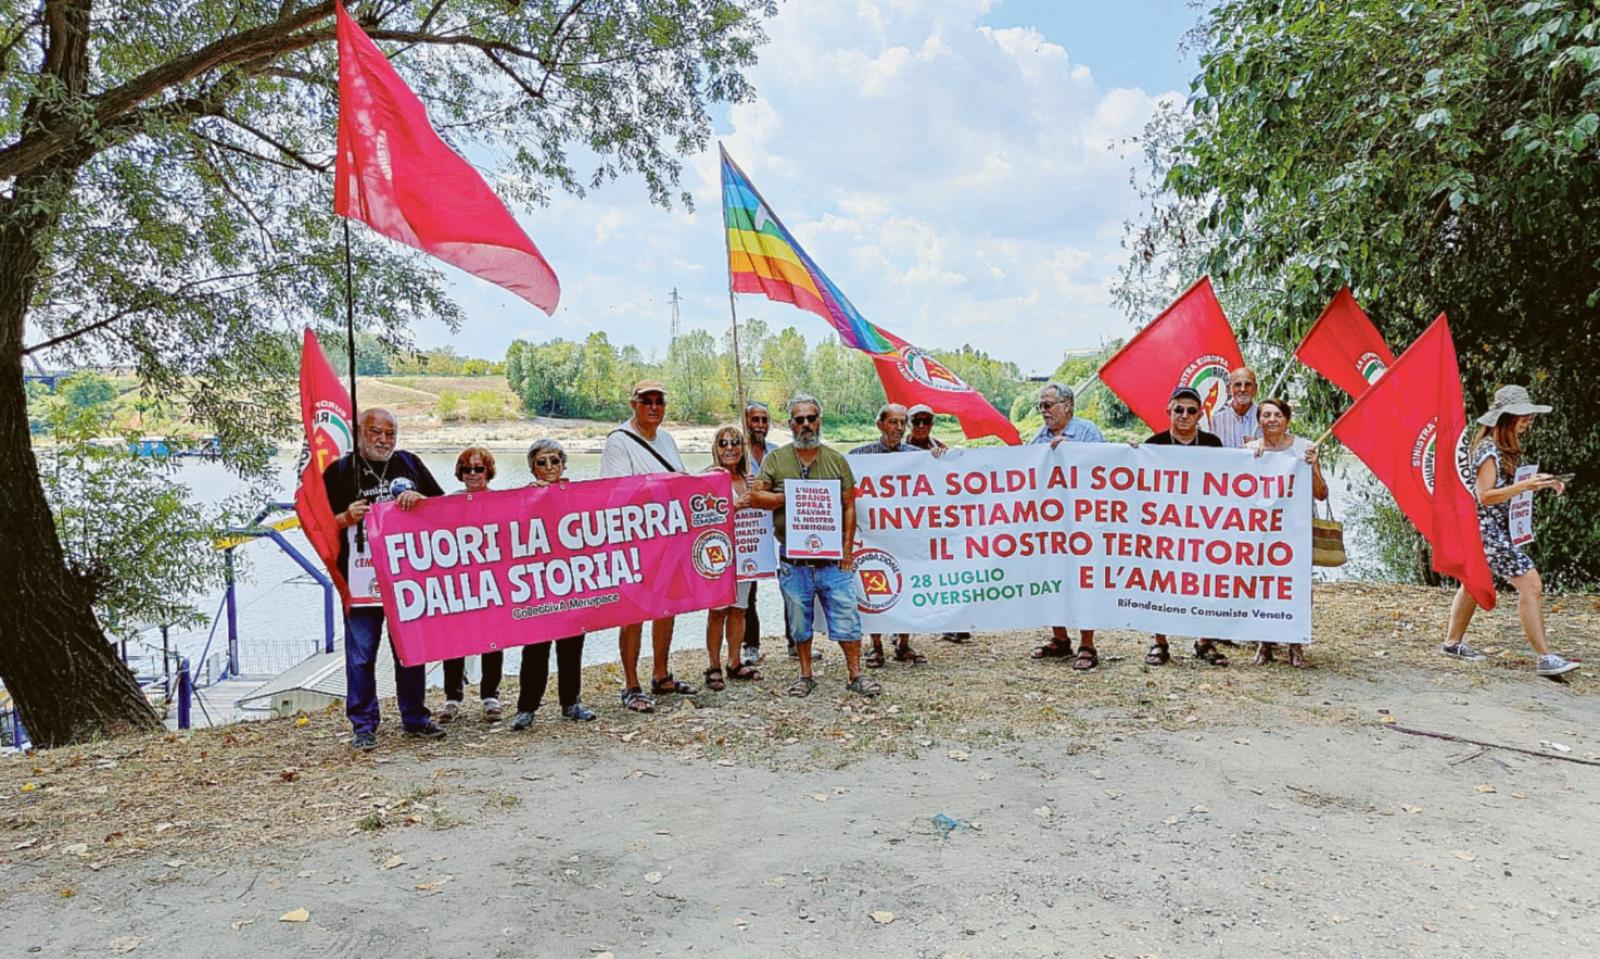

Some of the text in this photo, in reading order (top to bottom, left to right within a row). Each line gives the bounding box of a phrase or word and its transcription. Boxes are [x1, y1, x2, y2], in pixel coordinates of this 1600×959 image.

[857, 465, 1296, 499] ASTA SOLDI AI SOLITI NOTI!
[868, 498, 1284, 533] INVESTIAMO PER SALVARE
[385, 500, 689, 575] FUORI LA GUERRA
[929, 531, 1294, 567] IL NOSTRO TERRITORIO
[393, 546, 644, 622] DALLA STORIA!
[910, 567, 1005, 589] 28 LUGLIO
[912, 583, 1025, 607] OVERSHOOT
[1030, 579, 1063, 597] DAY
[1079, 566, 1294, 601] E L'AMBIENTE
[1117, 598, 1294, 621] Rifondazione Comunista Veneto
